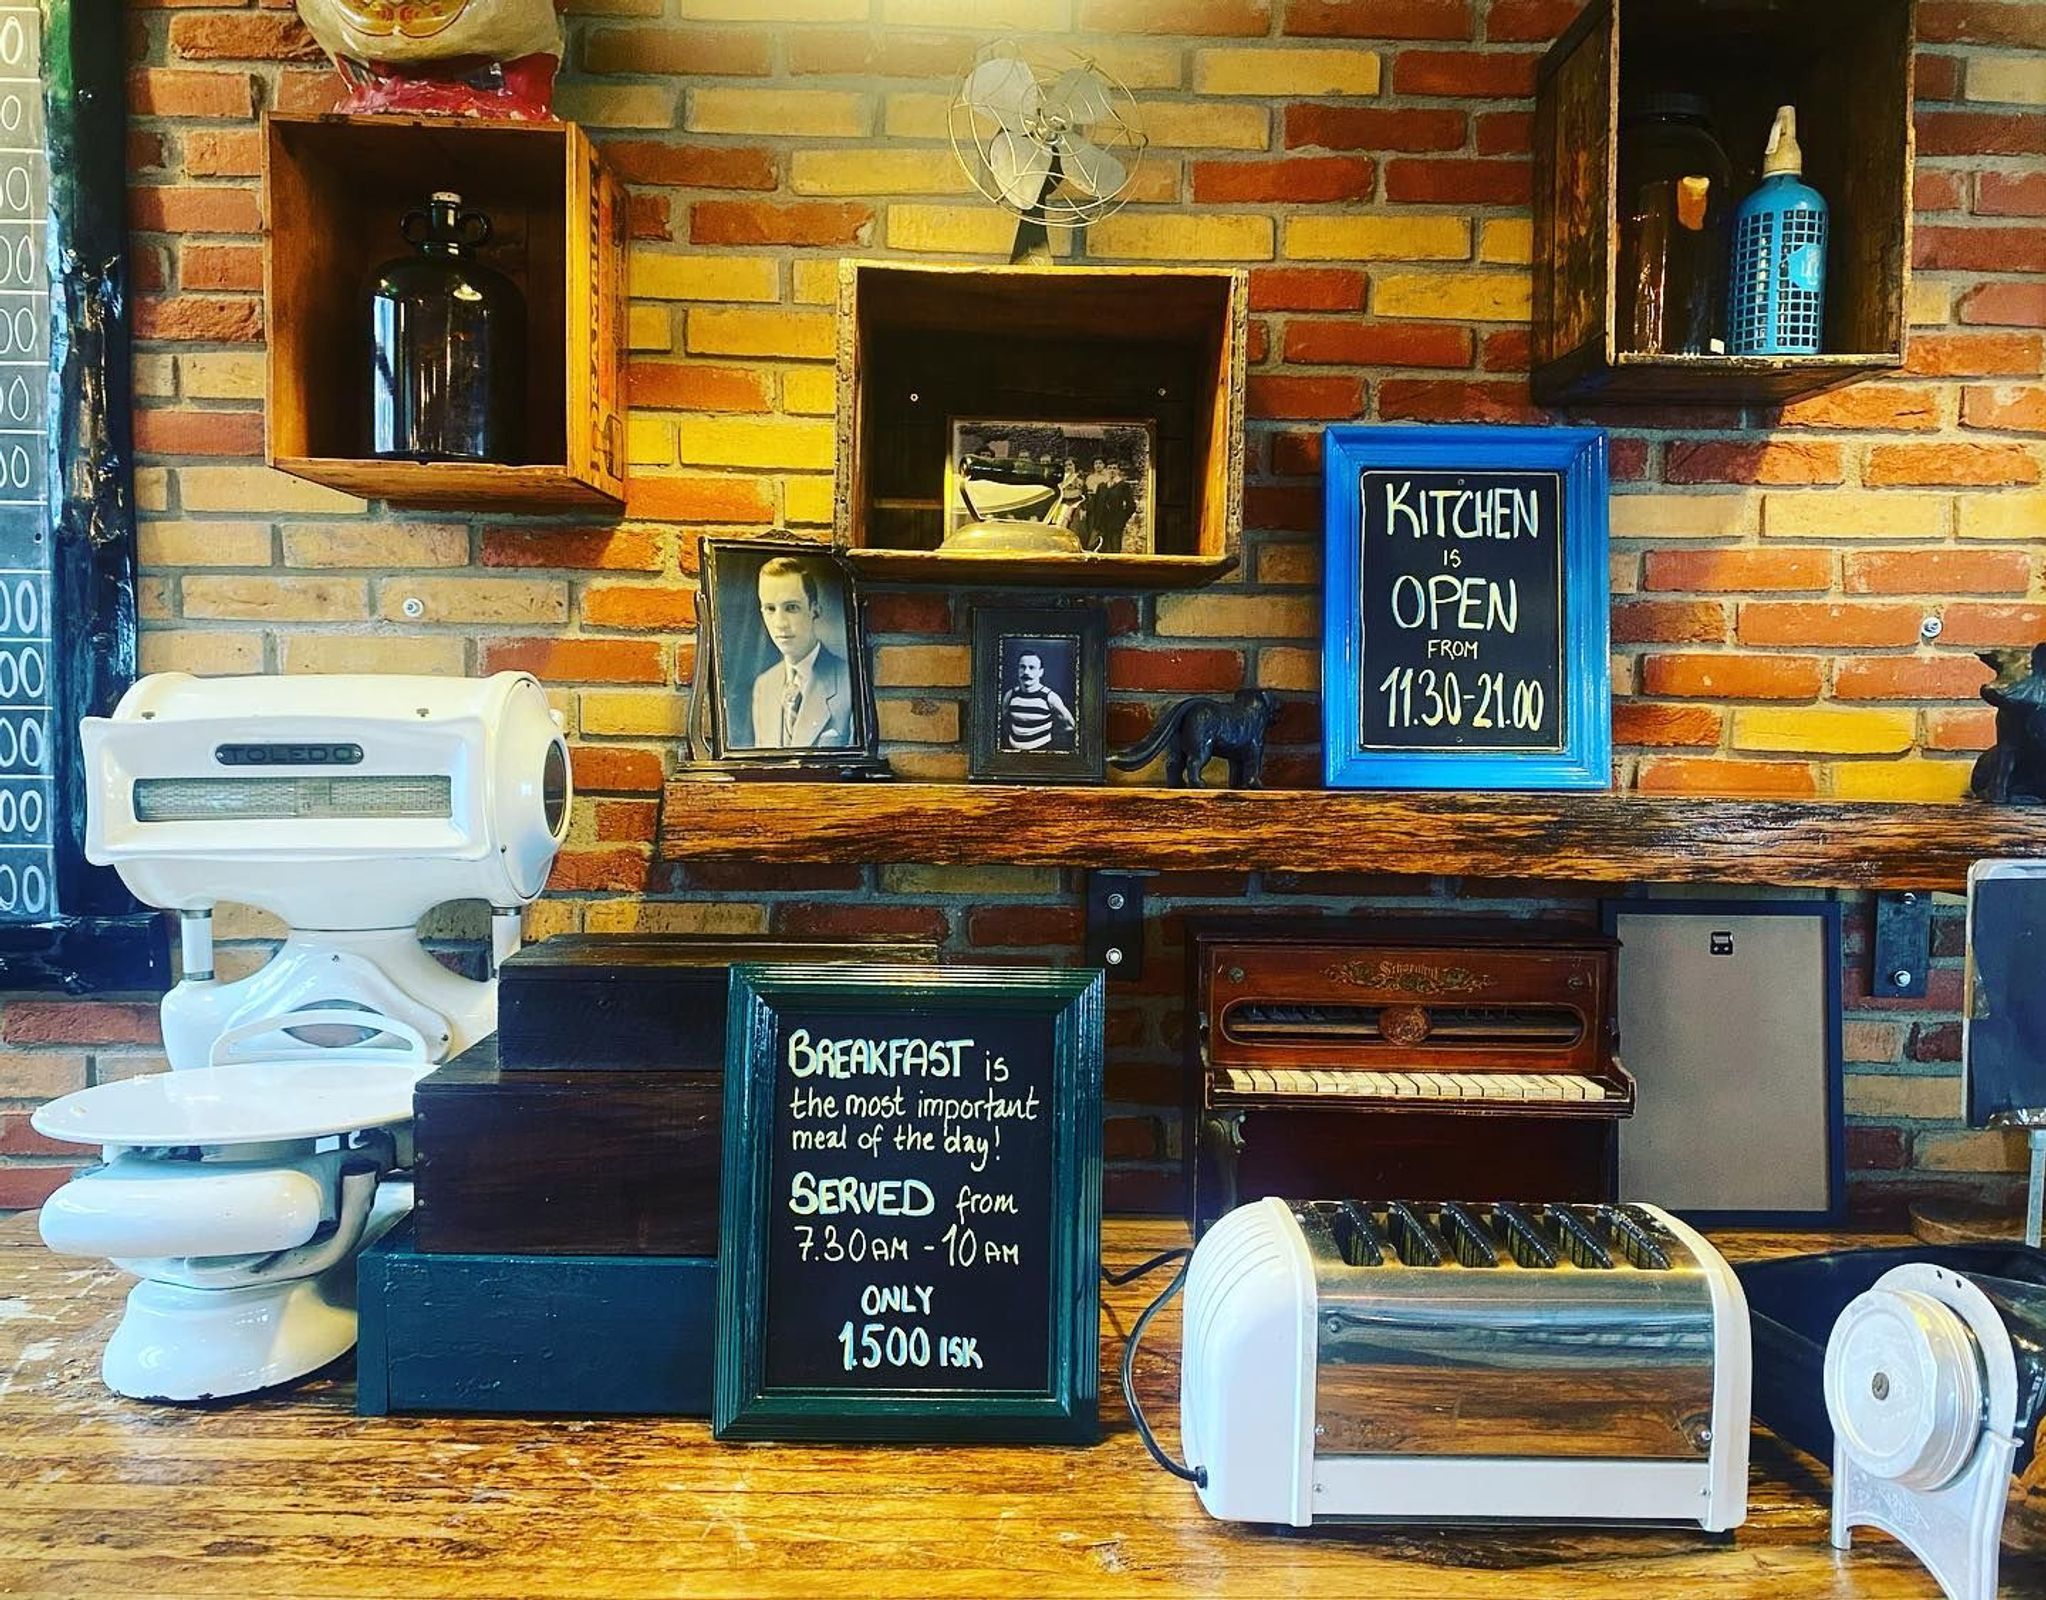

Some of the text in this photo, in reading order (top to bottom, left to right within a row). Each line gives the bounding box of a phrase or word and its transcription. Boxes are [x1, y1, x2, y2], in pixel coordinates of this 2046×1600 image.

[1385, 480, 1539, 539] KITCHEN
[1443, 549, 1462, 568] IS
[1391, 574, 1518, 634] OPEN
[1427, 639, 1479, 660] FROM
[1379, 666, 1544, 732] 11.30-21.00
[224, 746, 353, 762] TOLEDO
[788, 1028, 1009, 1082] BREAKFAST is
[789, 1086, 1040, 1134] the most important
[792, 1124, 1000, 1172] meal of the day!
[788, 1170, 1019, 1226] SERVED from
[860, 1284, 934, 1316] ONLY
[938, 1335, 984, 1370] ISK
